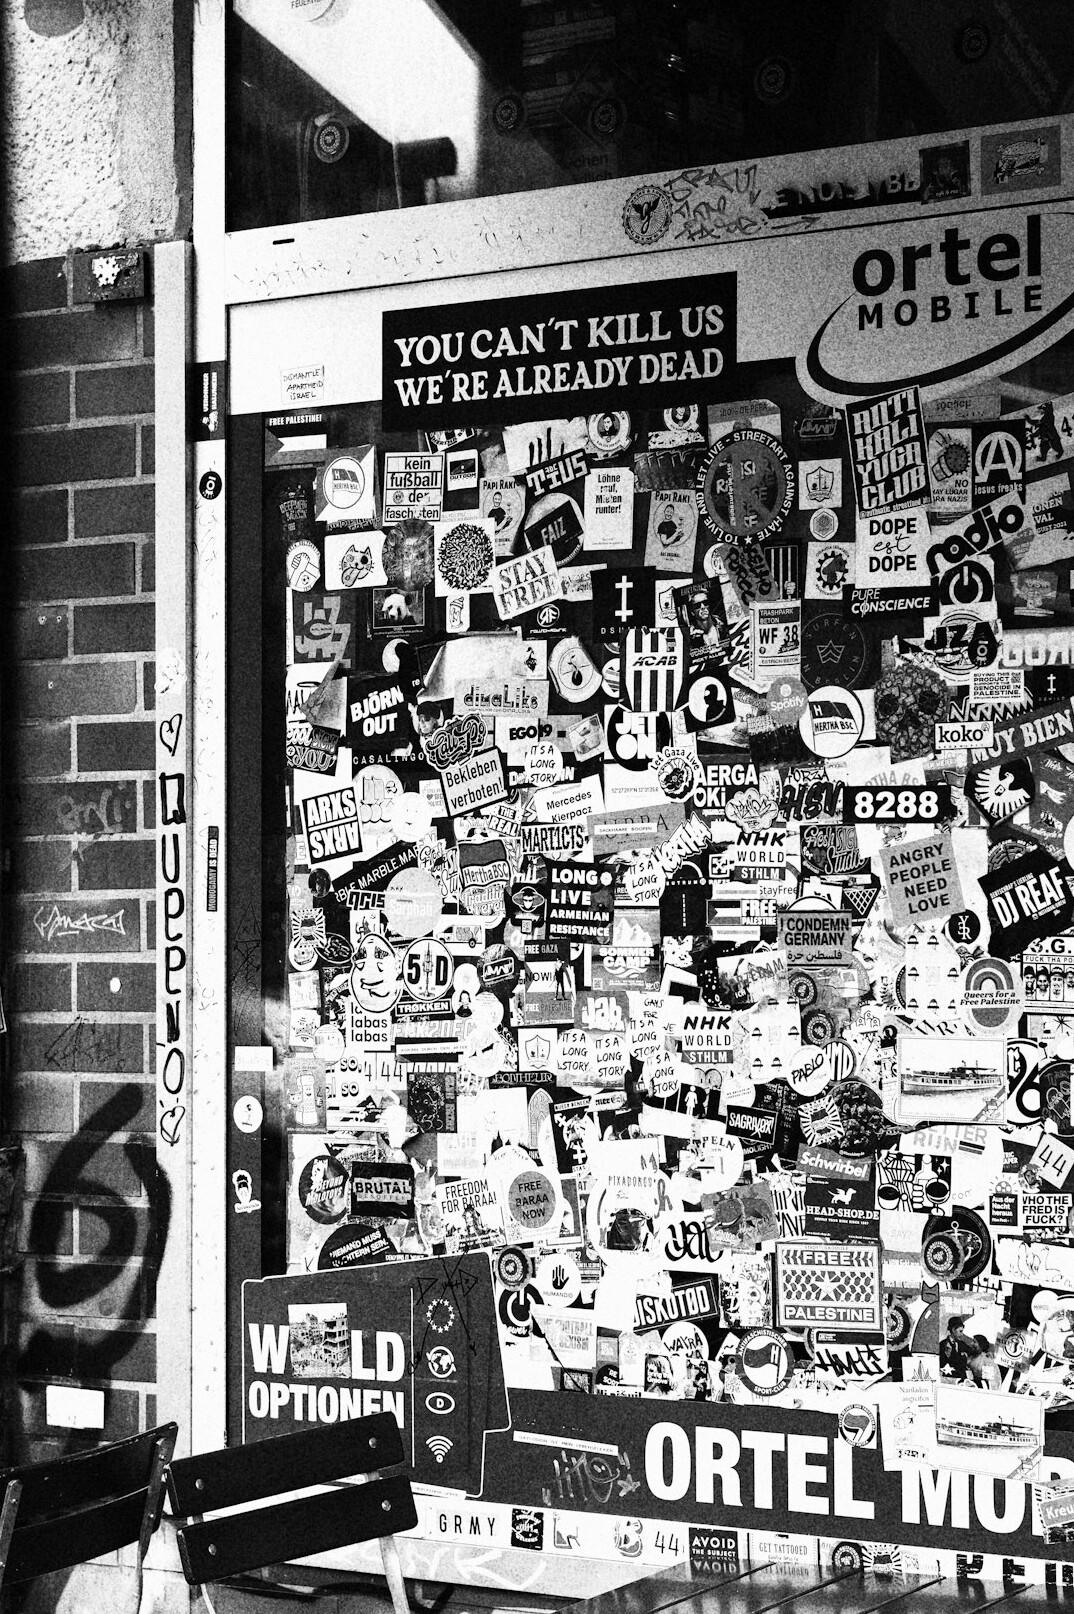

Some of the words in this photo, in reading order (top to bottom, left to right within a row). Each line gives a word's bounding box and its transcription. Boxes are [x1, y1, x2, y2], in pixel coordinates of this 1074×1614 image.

[852, 213, 1042, 297] ortel
[858, 285, 1042, 331] MOBILE
[394, 332, 464, 367] YOU
[587, 311, 672, 348] KILL
[679, 304, 724, 338] US
[494, 355, 635, 398] ALREADY
[639, 348, 724, 386] DEAD
[269, 417, 284, 426] FREE
[285, 413, 322, 425] PALESTINE!
[704, 440, 725, 465] LIVE
[733, 430, 788, 461] STREETART
[404, 458, 431, 471] kein
[390, 472, 438, 490] fußball
[597, 474, 621, 484] Löhne
[696, 465, 708, 489] LET
[954, 480, 968, 488] NO
[780, 463, 795, 516] AGAINST
[861, 466, 926, 510] CLUB
[974, 484, 996, 496] jesus
[655, 491, 671, 502] PAPI
[672, 491, 690, 503] RAKI
[696, 492, 708, 516] AND
[703, 515, 722, 542] LIVE
[757, 515, 784, 541] HATE
[869, 517, 917, 536] DOPE
[499, 551, 548, 590] STAY
[869, 554, 917, 573] DOPE
[851, 588, 881, 601] PURE
[759, 627, 778, 645] WF
[783, 624, 799, 643] 38
[350, 684, 405, 723] BJÖRN
[362, 712, 398, 737] OUT
[1020, 709, 1074, 748] BIEN
[938, 725, 984, 743] koko
[530, 758, 555, 770] LONG
[650, 755, 663, 771] Let
[664, 748, 685, 758] Gaza
[686, 751, 700, 771] Live
[445, 758, 498, 788] Bekleben
[530, 773, 557, 784] STORY
[450, 776, 506, 810] verboten!
[546, 790, 592, 810] Mercedes
[306, 789, 358, 828] ARXS
[499, 806, 516, 819] THE
[854, 790, 939, 819] 8288
[551, 805, 593, 824] Kierpacz
[489, 815, 520, 838] REAL
[736, 832, 786, 846] NHK
[208, 838, 217, 859] DEAD
[737, 850, 785, 863] WORLD
[889, 842, 944, 869] ANGRY
[551, 868, 598, 886] LONG
[741, 867, 780, 879] STHLM
[889, 858, 952, 885] PEOPLE
[208, 868, 217, 911] MONOGAMY
[632, 875, 658, 889] LONG
[904, 877, 948, 898] NEED
[550, 889, 592, 906] LIVE
[634, 887, 662, 903] STORY
[991, 891, 1020, 929] DJ
[1015, 866, 1066, 918] REAF
[741, 901, 777, 916] FREE
[908, 893, 951, 915] LOVE
[550, 909, 610, 922] ARMENIAN
[741, 916, 777, 925] PALESTINE
[550, 924, 610, 938] RESISTANCE
[786, 918, 849, 932] CONDEMN
[784, 932, 846, 946] GERMANY
[524, 944, 540, 954] FREE
[599, 947, 654, 957] SOMMER
[787, 951, 803, 962] حرة
[806, 951, 843, 962] فلسطين
[407, 953, 421, 985] 5
[435, 955, 449, 986] D
[603, 956, 651, 968] CAMP
[960, 998, 979, 1006] Free
[980, 997, 1021, 1006] Palestine
[964, 990, 994, 999] Queers
[995, 990, 1009, 998] for
[350, 1015, 388, 1028] labas
[683, 1015, 732, 1030] NHK
[350, 1029, 388, 1042] labas
[631, 1031, 657, 1044] LONG
[684, 1034, 732, 1046] WORLD
[562, 1047, 588, 1058] LONG
[596, 1051, 623, 1063] LONG
[689, 1051, 728, 1064] STHLM
[598, 1065, 625, 1078] STORY
[800, 1151, 868, 1178] Schwirbel
[1038, 1144, 1067, 1178] 44
[355, 1181, 410, 1195] BRUTAL
[445, 1178, 489, 1199] FREEDOM
[518, 1180, 542, 1193] FREE
[441, 1196, 460, 1214] FOR
[515, 1193, 549, 1208] BARAA
[1049, 1195, 1069, 1205] THE
[522, 1208, 546, 1221] NOW
[806, 1205, 880, 1221] HEAD-SHOP.DE
[1022, 1205, 1053, 1215] FRED
[1054, 1205, 1066, 1214] IS
[1025, 1215, 1064, 1224] FUCK?
[803, 1251, 852, 1265] FREE
[785, 1306, 874, 1322] PALESTINE
[248, 1380, 405, 1429] OPTIONEN
[644, 1421, 875, 1519] ORTEL
[692, 1536, 736, 1550] AVOID
